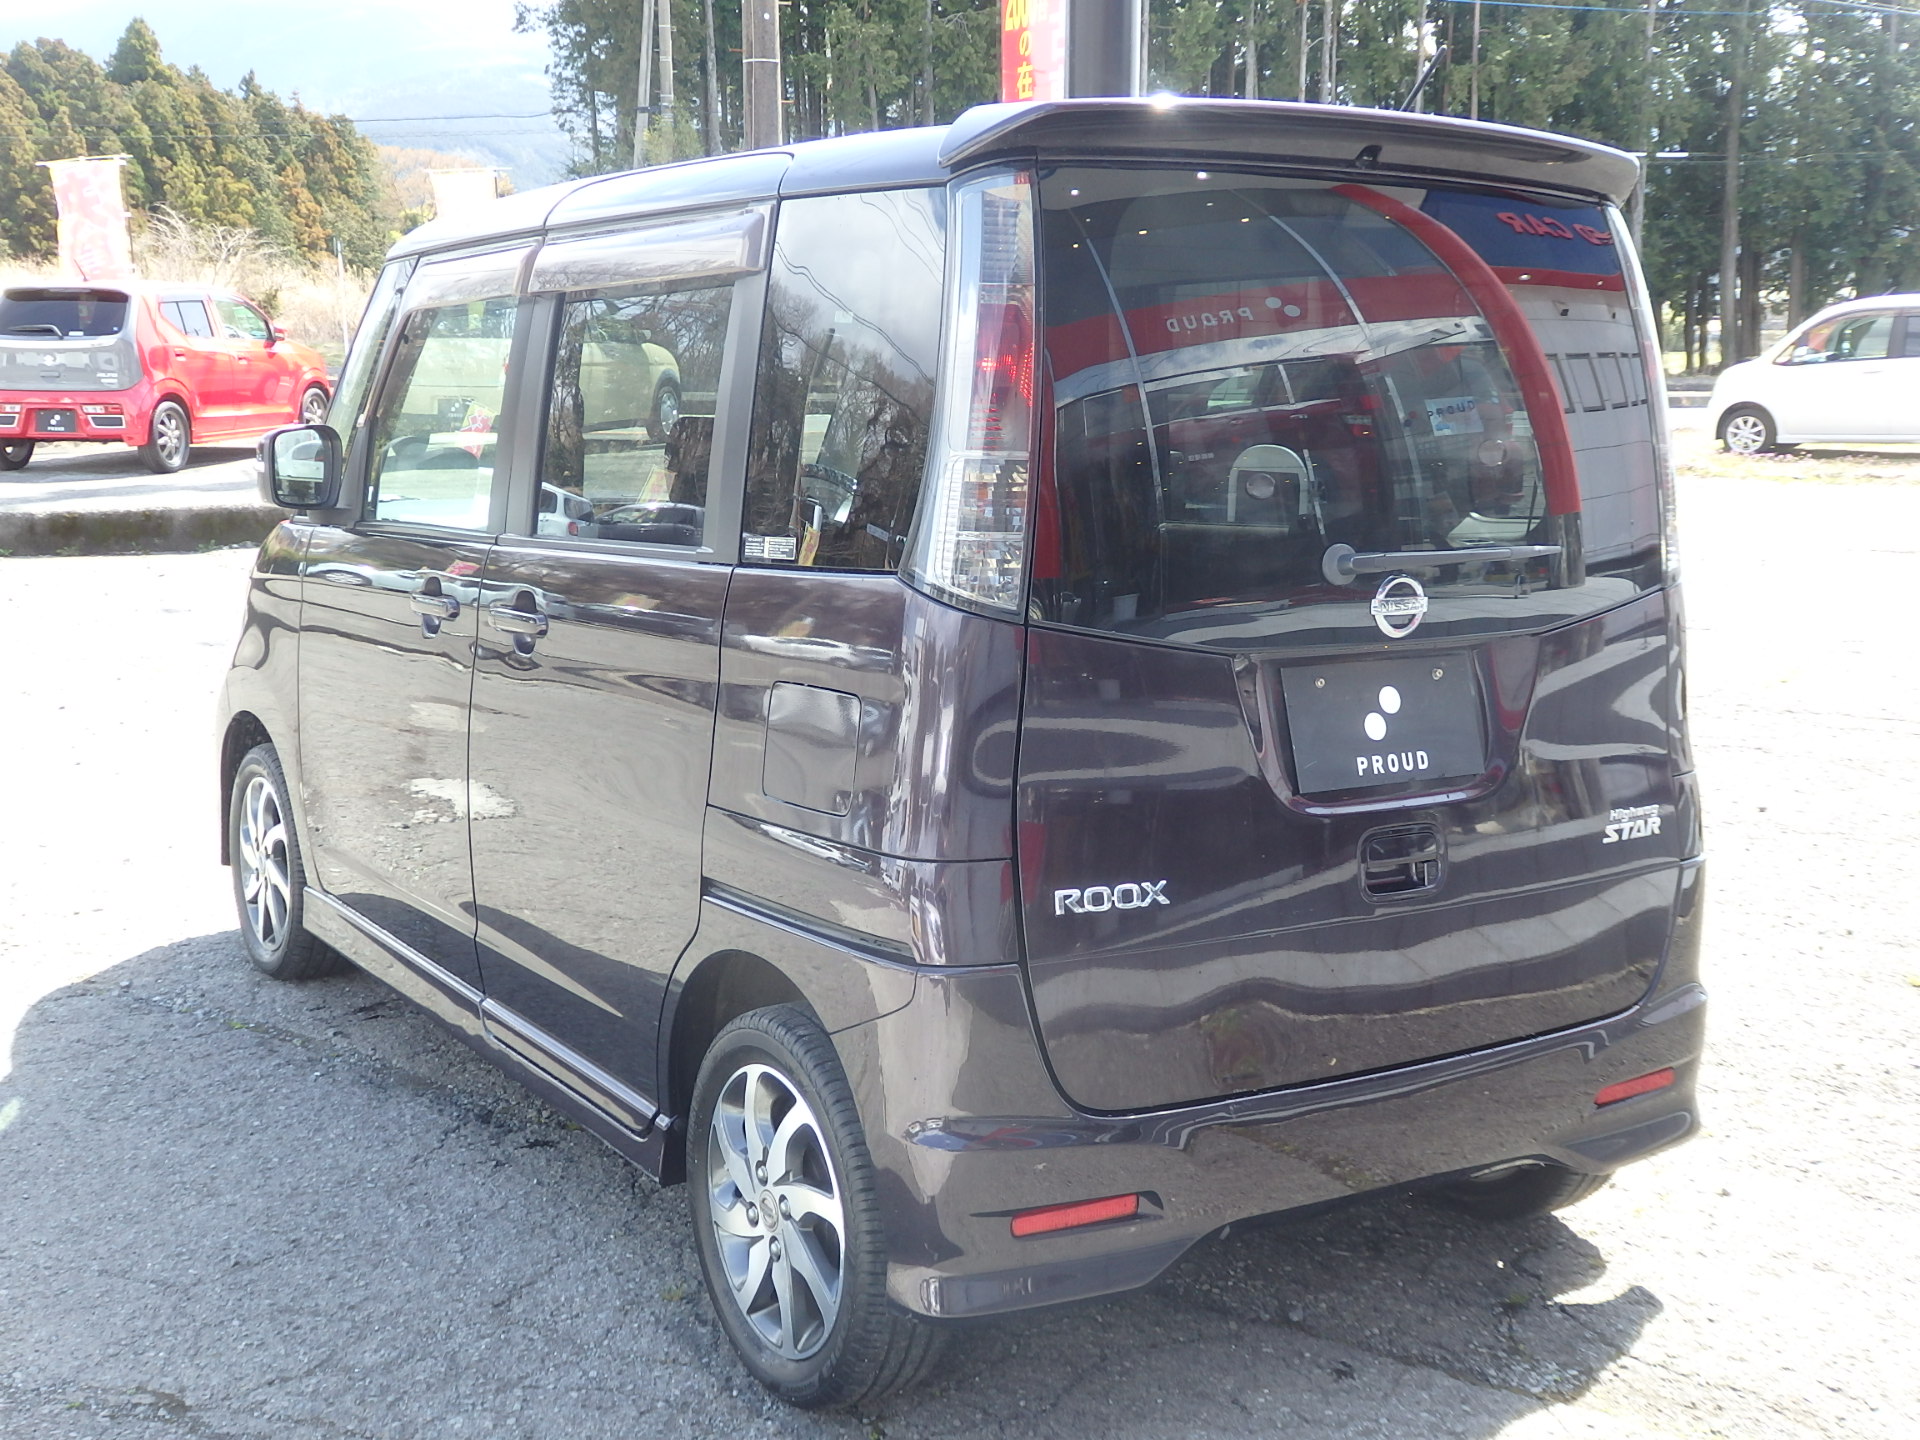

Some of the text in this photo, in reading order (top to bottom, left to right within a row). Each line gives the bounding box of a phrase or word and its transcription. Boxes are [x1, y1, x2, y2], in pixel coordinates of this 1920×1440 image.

[1356, 750, 1429, 776] PROUD
[1602, 817, 1661, 844] STAR
[1055, 880, 1170, 915] ROOX
